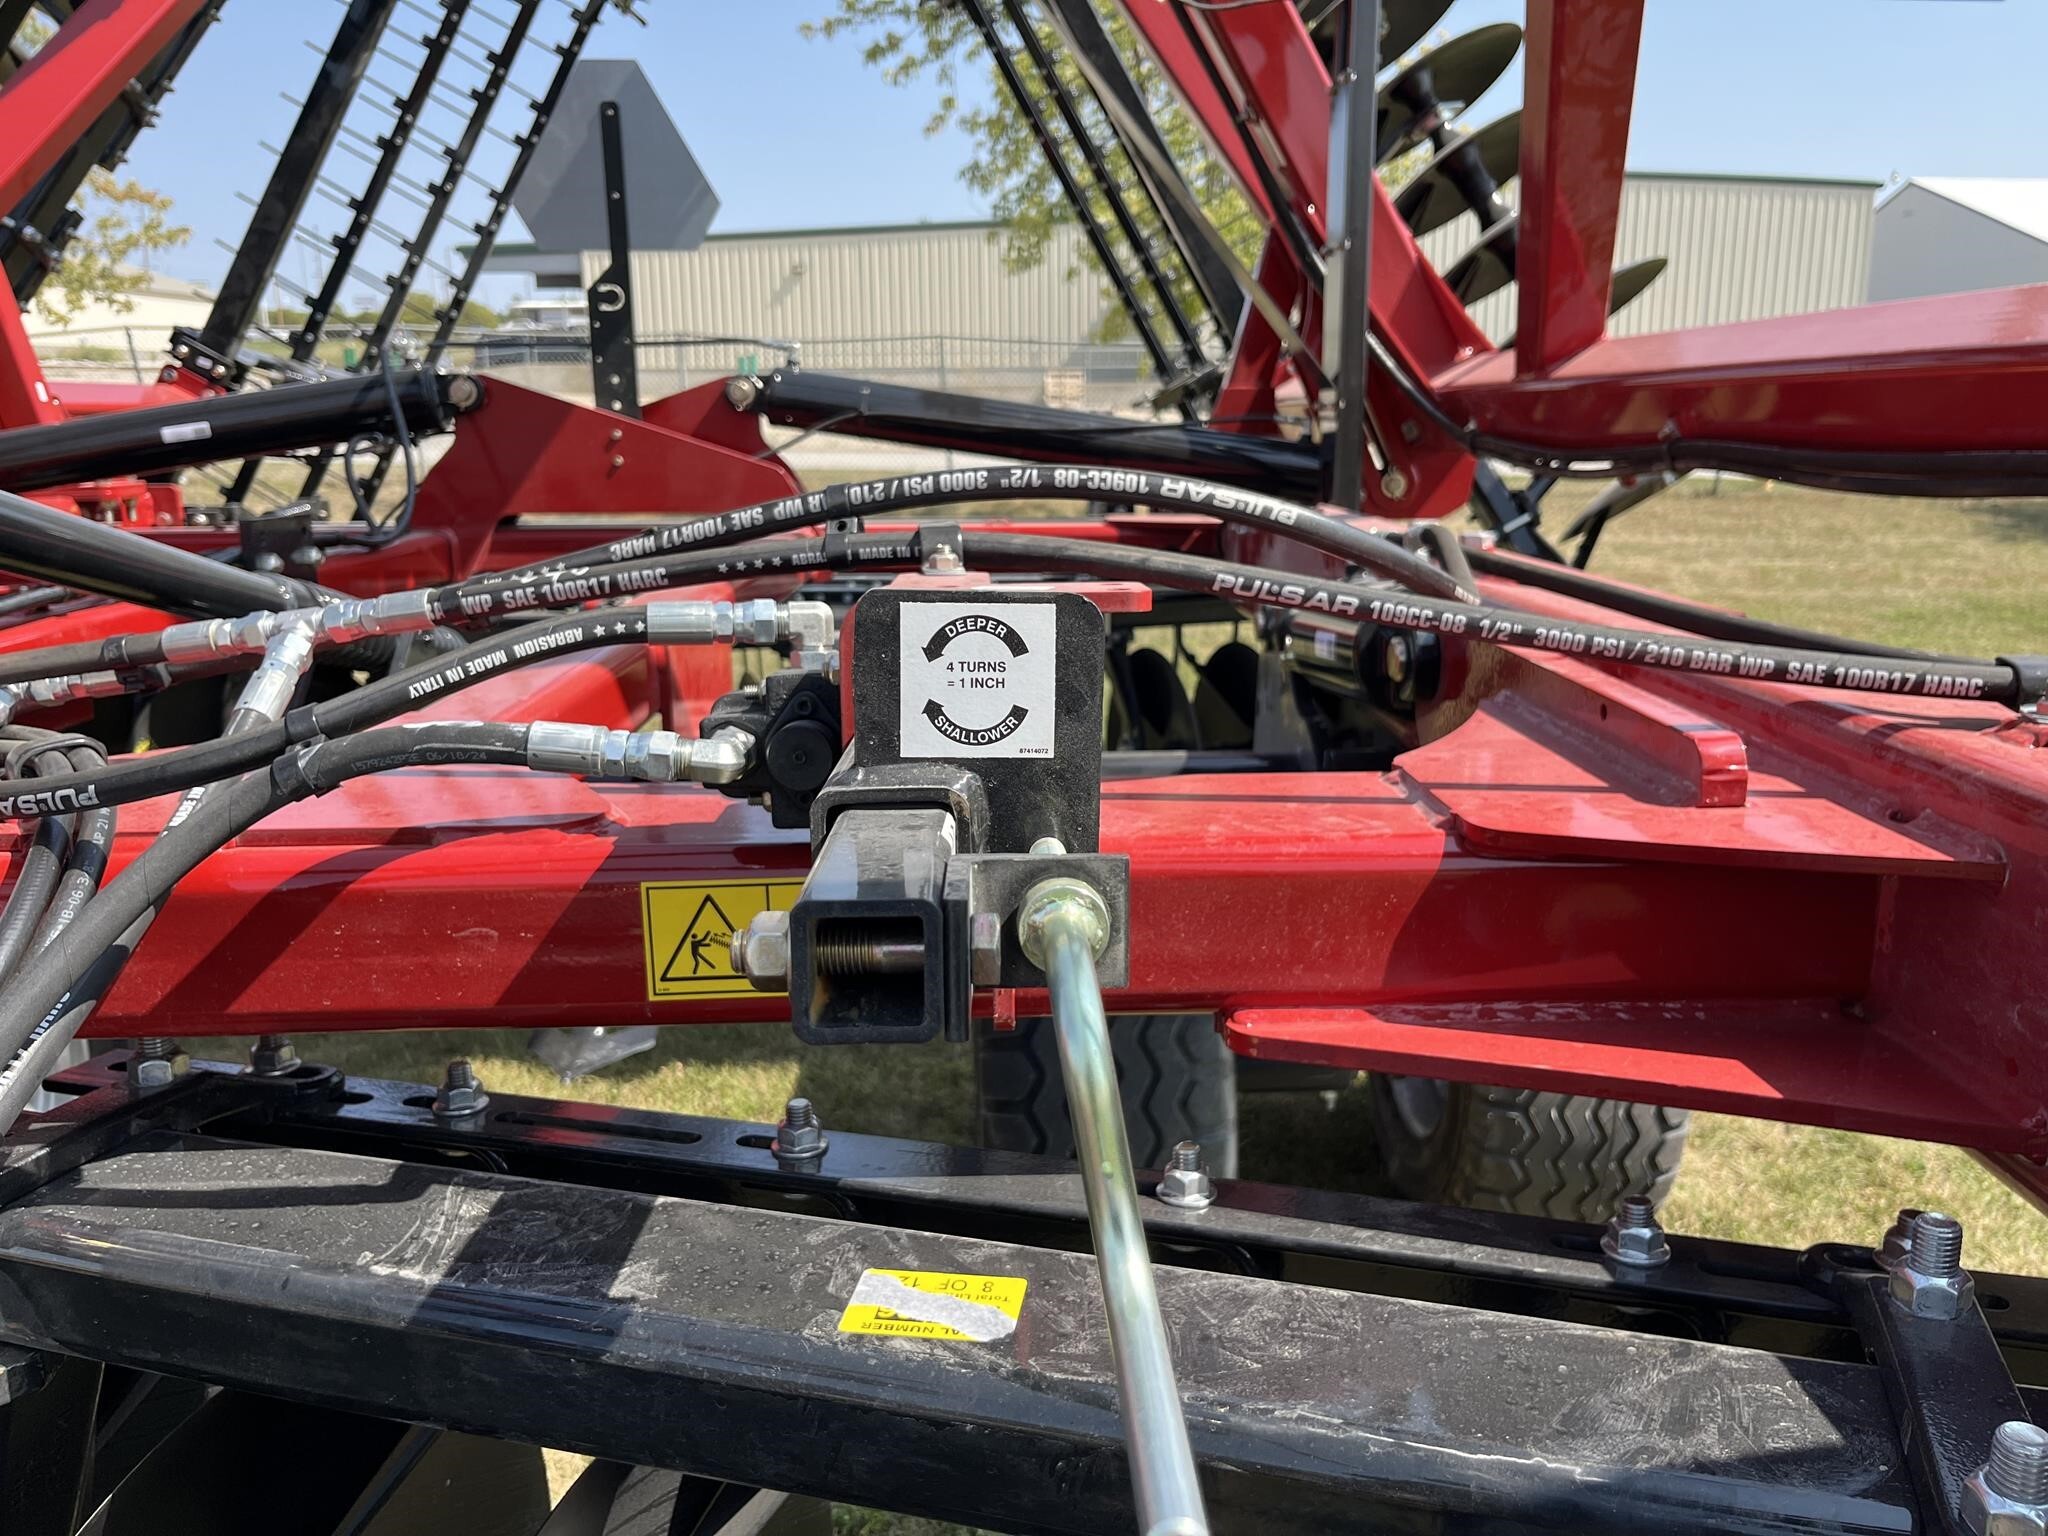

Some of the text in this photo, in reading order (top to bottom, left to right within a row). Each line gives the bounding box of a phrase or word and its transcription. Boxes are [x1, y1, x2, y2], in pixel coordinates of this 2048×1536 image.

[890, 479, 898, 500] /
[903, 477, 934, 498] PSI
[939, 470, 988, 493] 3000
[1001, 468, 1042, 489] 1/2"
[1053, 468, 1150, 494] 109CC-08
[850, 482, 886, 505] 210
[1160, 477, 1299, 526] PULSAR
[731, 507, 764, 531] SAE
[773, 498, 802, 521] WP
[663, 517, 727, 549] 100R17
[610, 535, 657, 562] HARC
[461, 592, 493, 616] WP
[502, 587, 539, 609] SAE
[542, 574, 611, 602] 100R17
[617, 567, 669, 592] HARC
[859, 546, 895, 560] MADE
[896, 546, 911, 559] IN
[944, 618, 1007, 638] DEEPER
[1212, 572, 1984, 698] PULSAR 109CC-08 1/2" 3000 PSI / 210 BAR WP SAE 100R17 HARC
[408, 626, 583, 699] ABRASION MADE IN ITALY
[946, 661, 1007, 673] 4 TURNS
[959, 677, 965, 688] 1
[970, 677, 1006, 689] INCH
[934, 715, 1019, 743] SHALLOWER
[939, 1279, 968, 1291] OF
[981, 1281, 995, 1293] 8
[861, 1321, 935, 1334] NUMBER
